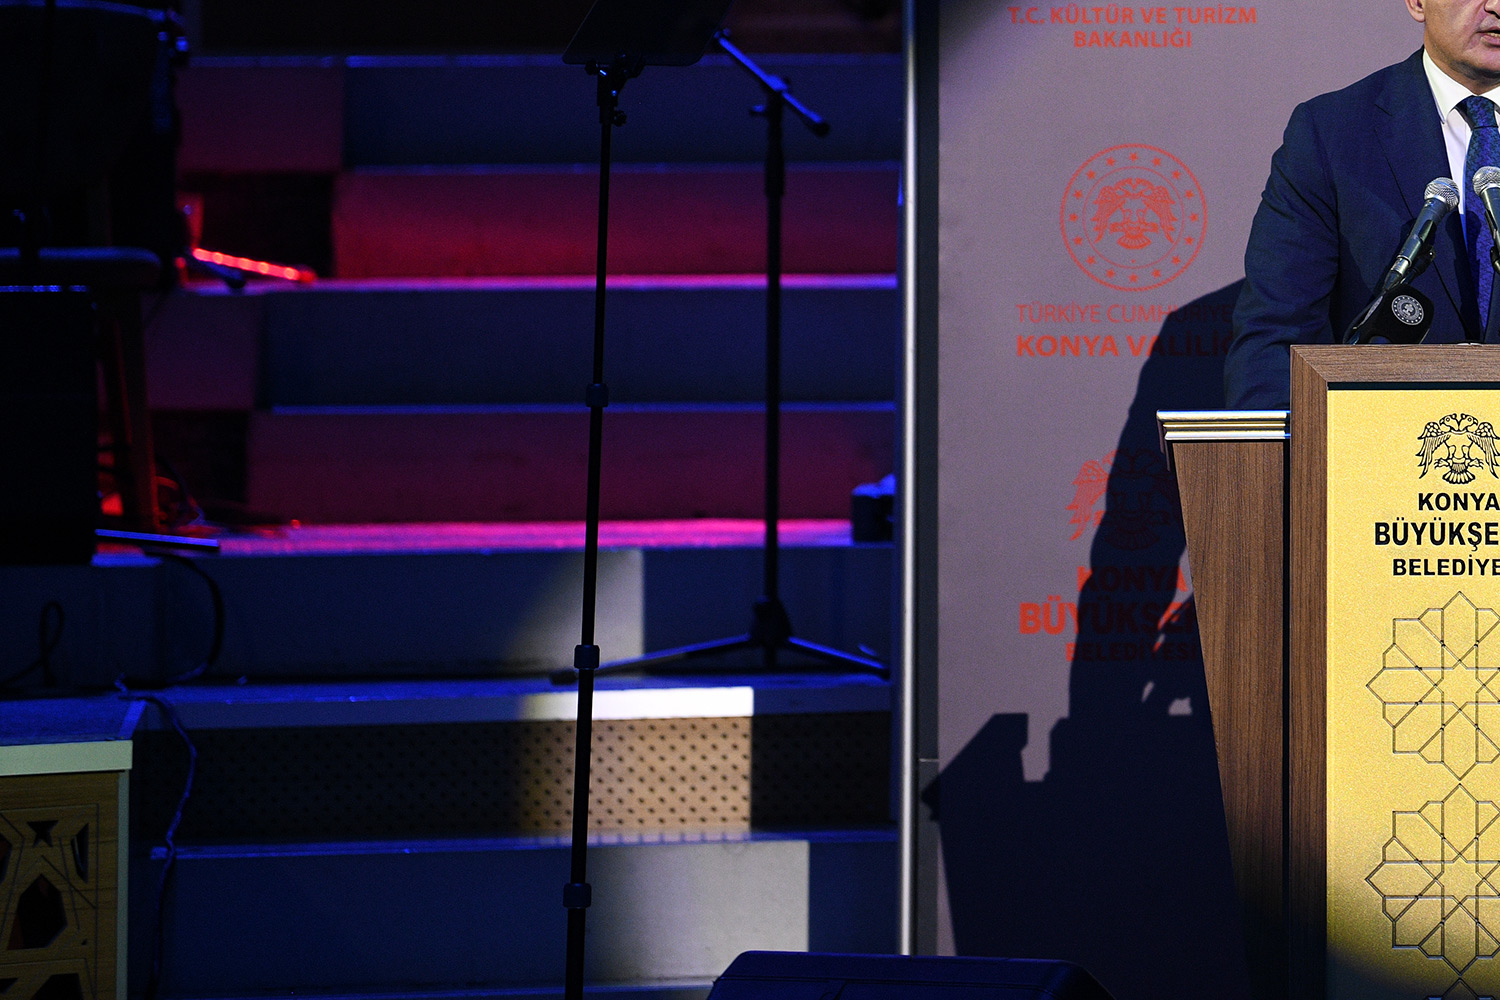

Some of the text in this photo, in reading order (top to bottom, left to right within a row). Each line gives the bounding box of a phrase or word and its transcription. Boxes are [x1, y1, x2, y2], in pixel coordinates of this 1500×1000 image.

[1008, 3, 1257, 24] T.C. KÜLTÜR VE TURİZM
[1074, 27, 1192, 48] BAKANLIĞI
[1016, 301, 1233, 324] TÜRKİYE CUMHURİYE
[1017, 335, 1120, 357] KONYA
[1418, 493, 1500, 511] KONYA
[1077, 565, 1188, 592] KONYA
